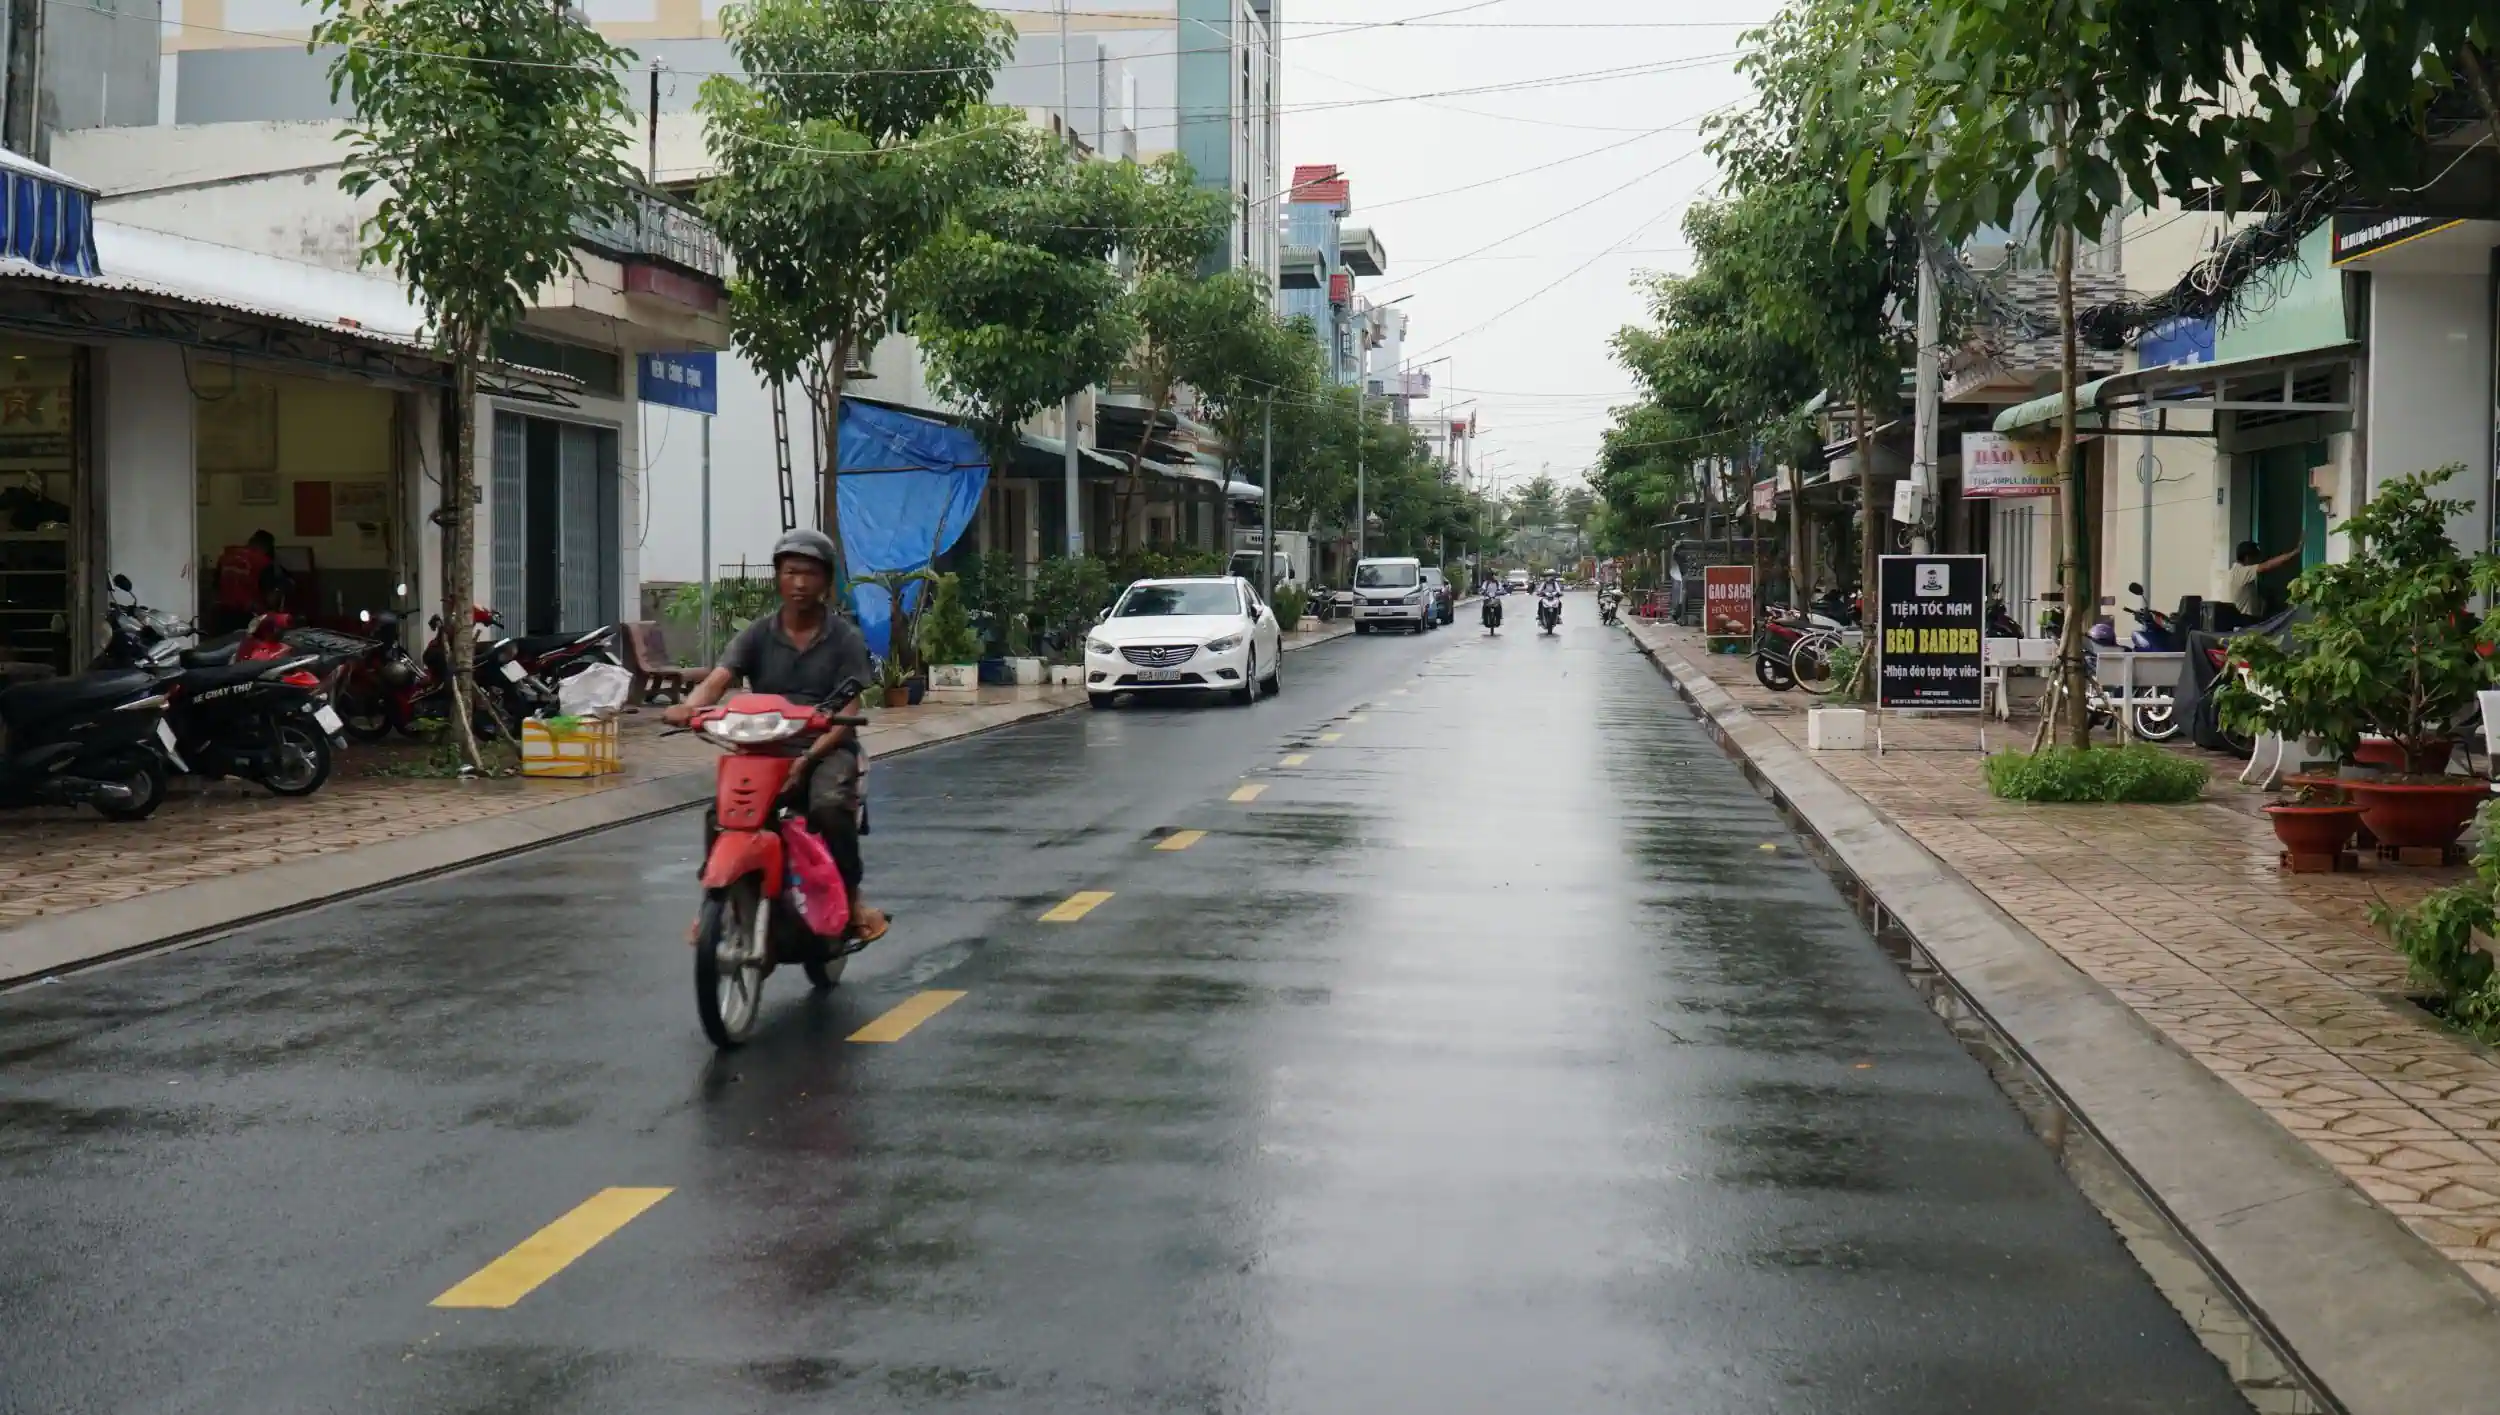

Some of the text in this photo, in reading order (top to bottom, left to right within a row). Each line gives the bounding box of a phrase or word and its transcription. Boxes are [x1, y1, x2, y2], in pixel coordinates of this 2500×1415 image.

[1890, 600, 1973, 618] TIỆM TÓC NAM
[1919, 628, 1979, 654] BARBER
[1927, 665, 1942, 680] tạo
[1943, 664, 1958, 680] học
